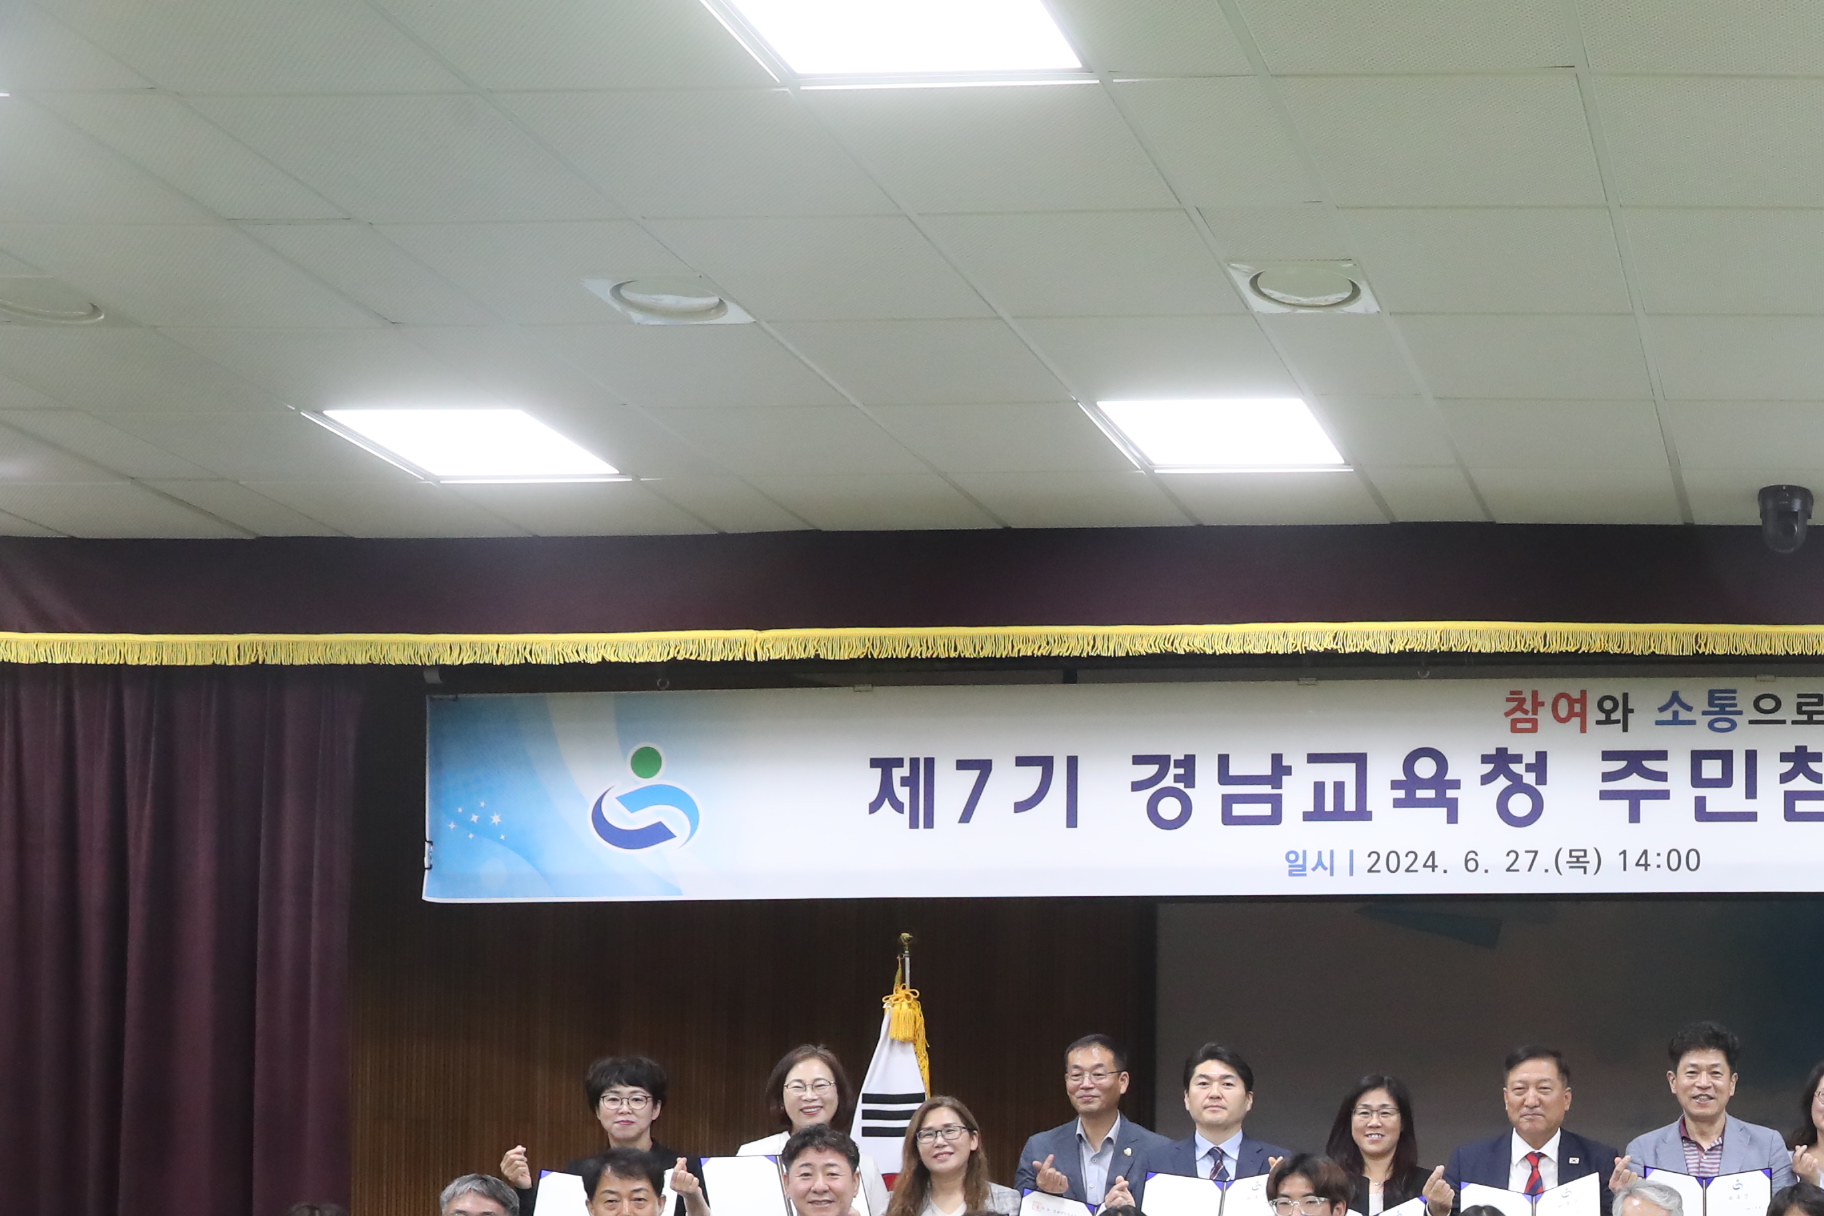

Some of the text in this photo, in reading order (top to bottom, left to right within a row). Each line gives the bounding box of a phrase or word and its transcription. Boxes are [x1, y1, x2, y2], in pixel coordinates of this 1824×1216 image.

[1503, 689, 1634, 733] 참여와
[868, 755, 1079, 830] 제7기
[1131, 746, 1548, 830] 경남교육청
[1284, 847, 1702, 877] 일시 2024. 6. 27.(목) 14:00
